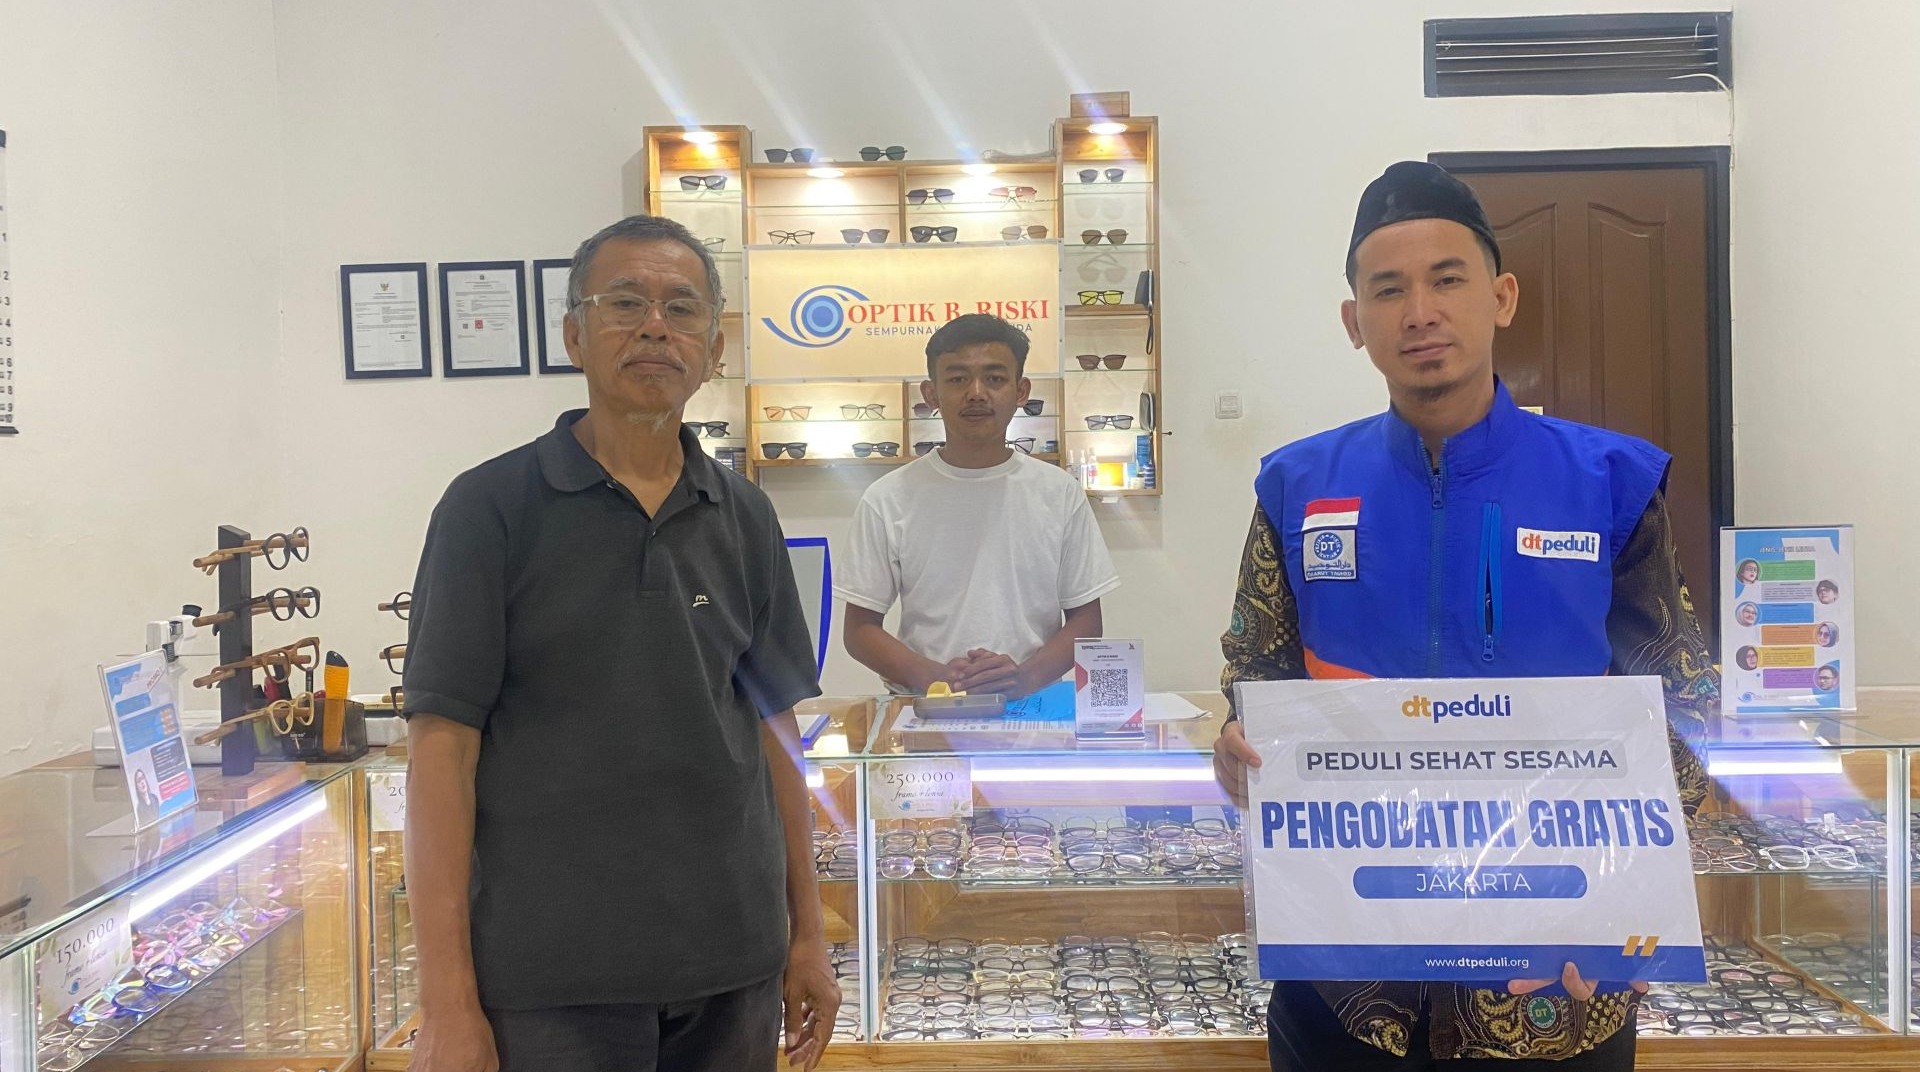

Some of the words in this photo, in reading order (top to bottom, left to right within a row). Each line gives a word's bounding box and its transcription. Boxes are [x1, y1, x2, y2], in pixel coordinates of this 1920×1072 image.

[3, 270, 9, 281] 2
[4, 296, 11, 306] 3
[848, 303, 936, 324] OPTIK
[975, 299, 1049, 321] RISKI
[5, 318, 11, 327] 4
[866, 325, 940, 337] SEMPURNAK
[6, 336, 12, 347] 5
[6, 357, 13, 368] 6
[6, 370, 13, 381] 7
[7, 385, 13, 395] 8
[7, 402, 13, 413] 9
[1320, 541, 1335, 551] DT
[1521, 533, 1596, 556] dtpeduli
[1401, 693, 1511, 724] dtpeduli
[1306, 751, 1402, 771] PEDULI
[1409, 750, 1497, 771] SEHAT
[1503, 749, 1618, 770] SESAMA
[886, 771, 954, 788] 250.000
[1260, 800, 1517, 849] PENGOBATAN
[1527, 798, 1675, 848] GRATIS
[1416, 872, 1532, 892] JAKARTA
[57, 917, 114, 966] 150.000
[1424, 956, 1530, 969] www.dtpeduli.org
[1534, 1007, 1548, 1018] DT
